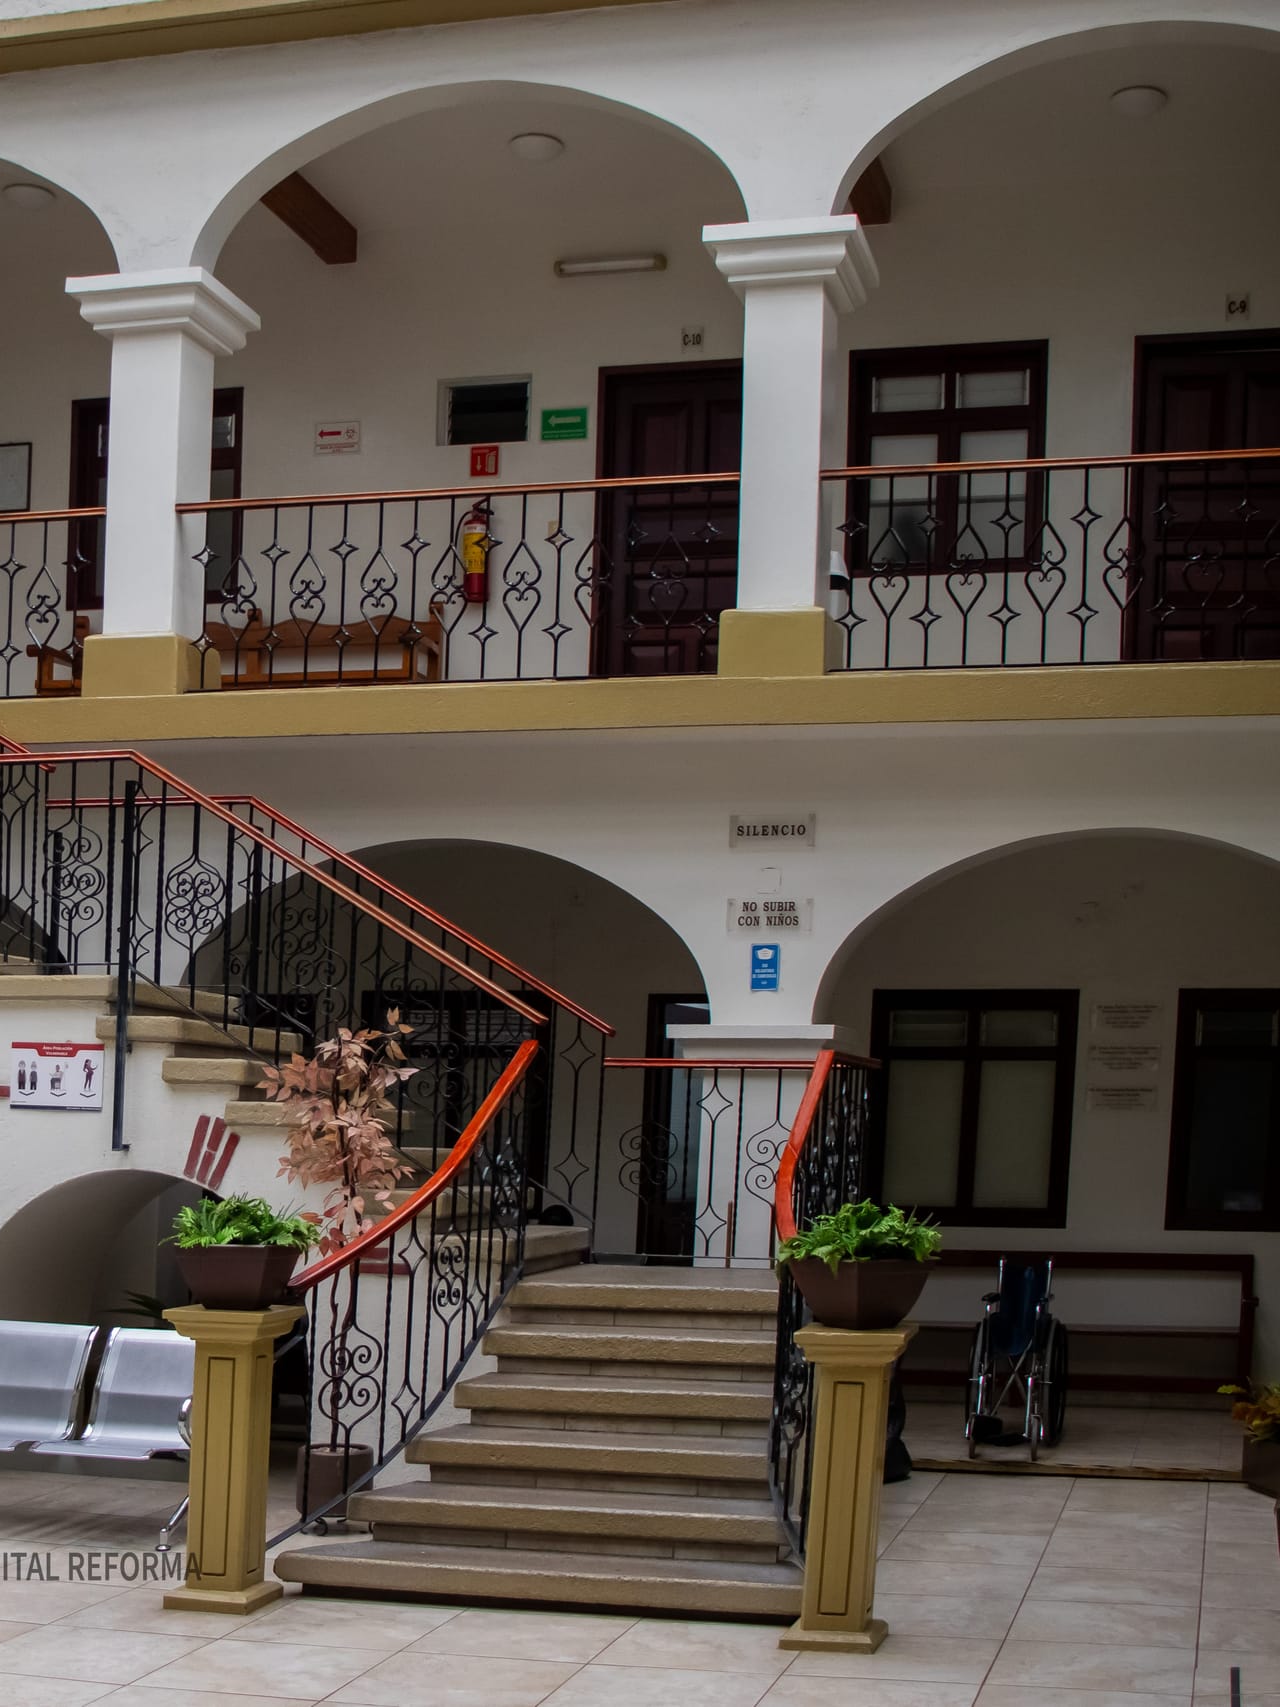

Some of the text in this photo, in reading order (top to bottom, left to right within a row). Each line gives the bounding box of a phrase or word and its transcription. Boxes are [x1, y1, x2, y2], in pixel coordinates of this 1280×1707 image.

[1228, 300, 1247, 314] C-9
[683, 333, 702, 346] C-10
[736, 824, 806, 837] SILENCIO
[742, 901, 796, 912] NO SUBIR
[737, 913, 800, 927] CON NIÑOS
